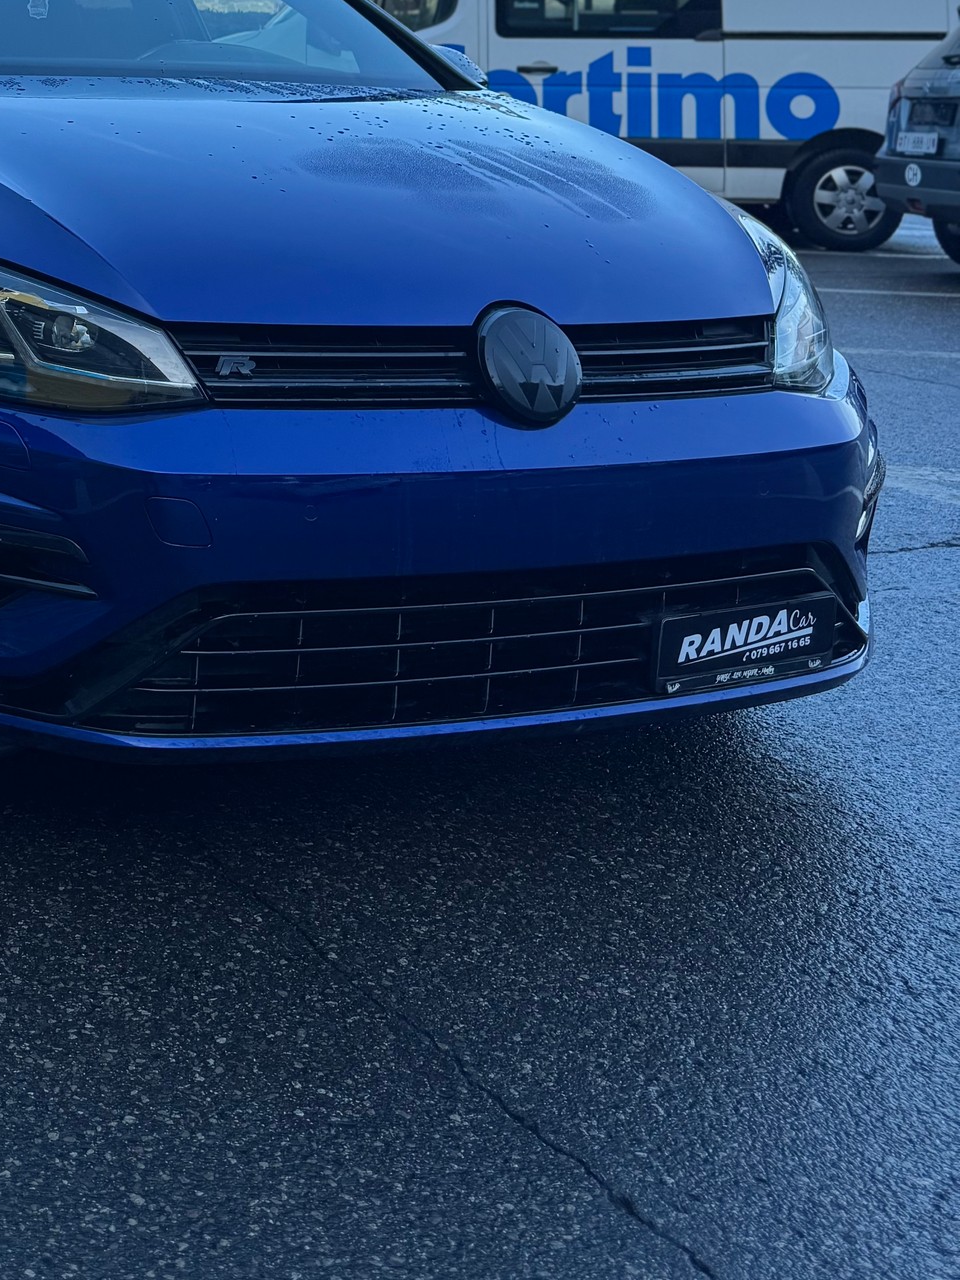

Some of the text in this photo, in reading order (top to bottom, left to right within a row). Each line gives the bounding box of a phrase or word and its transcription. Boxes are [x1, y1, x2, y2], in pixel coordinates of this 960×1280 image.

[437, 43, 841, 141] rtimo
[907, 166, 918, 183] CH
[677, 608, 817, 663] RANDA Car
[750, 636, 811, 660] 079 667 16 65
